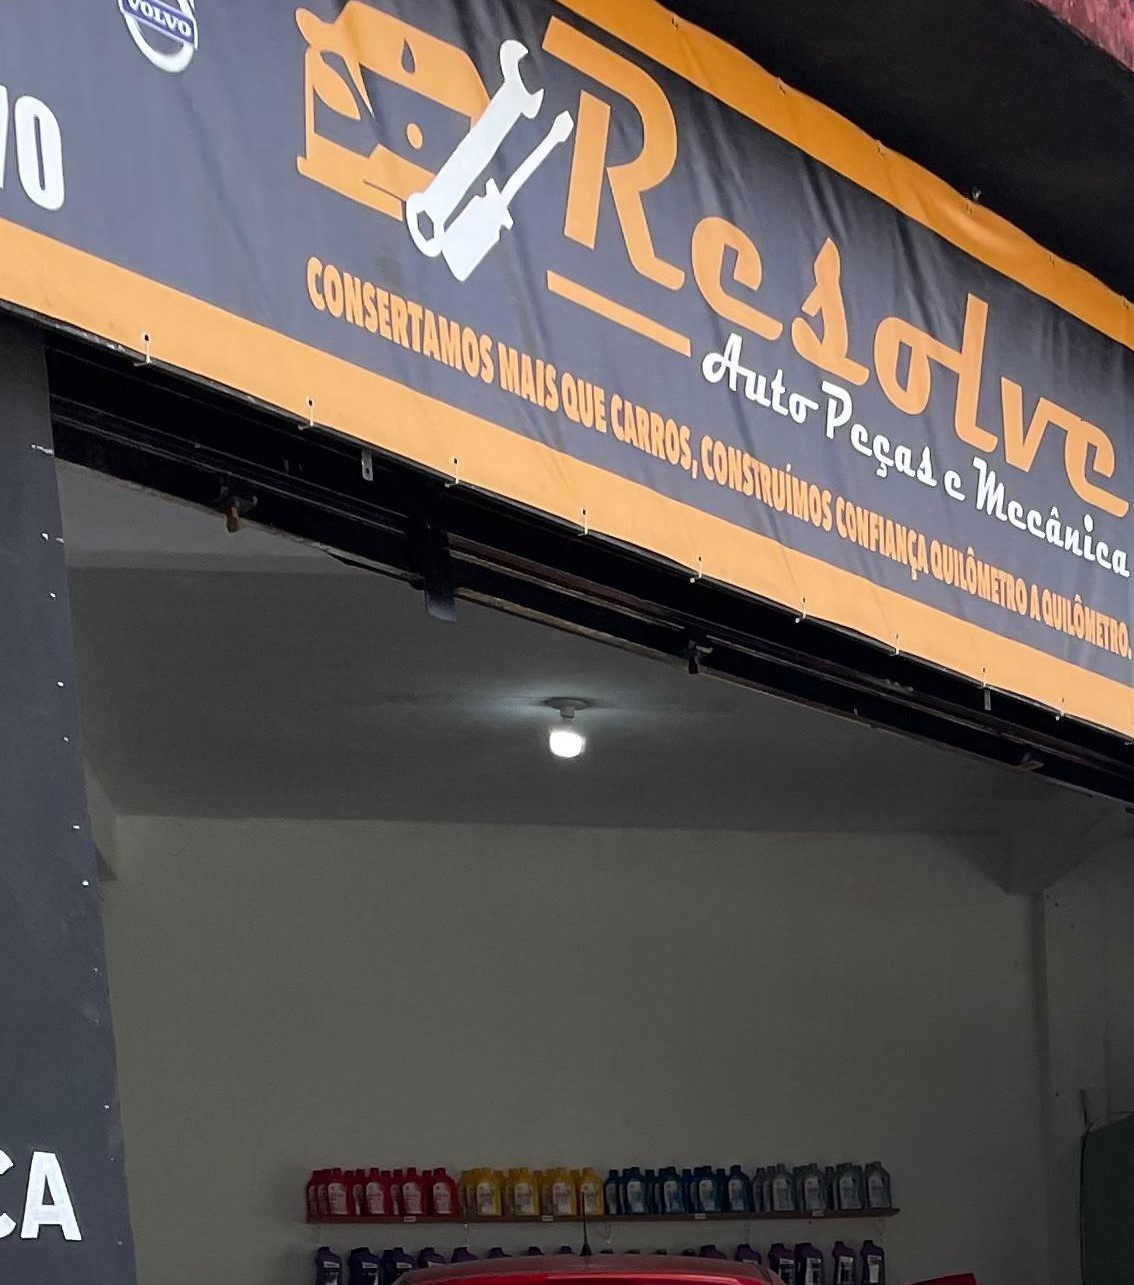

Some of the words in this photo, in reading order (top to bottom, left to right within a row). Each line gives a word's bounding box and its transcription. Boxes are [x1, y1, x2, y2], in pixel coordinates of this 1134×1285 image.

[127, 0, 192, 37] VOLVO
[0, 83, 65, 211] O
[542, 15, 1130, 518] Resolve
[306, 256, 495, 384] CONSERTAMOS
[497, 341, 559, 412] MAIS
[561, 371, 608, 433] QUE
[610, 393, 698, 480] CARROS,
[700, 433, 833, 533] CONSTRUÍMOS
[835, 495, 930, 581] CONFIANÇA
[930, 546, 1028, 617] QUILÔMETRO
[1029, 584, 1042, 621] A
[1042, 594, 1133, 660] QUILÔMETRO.
[702, 332, 819, 424] Auto
[821, 380, 938, 488] Peças
[943, 471, 966, 501] e
[972, 455, 1131, 578] Mecânica
